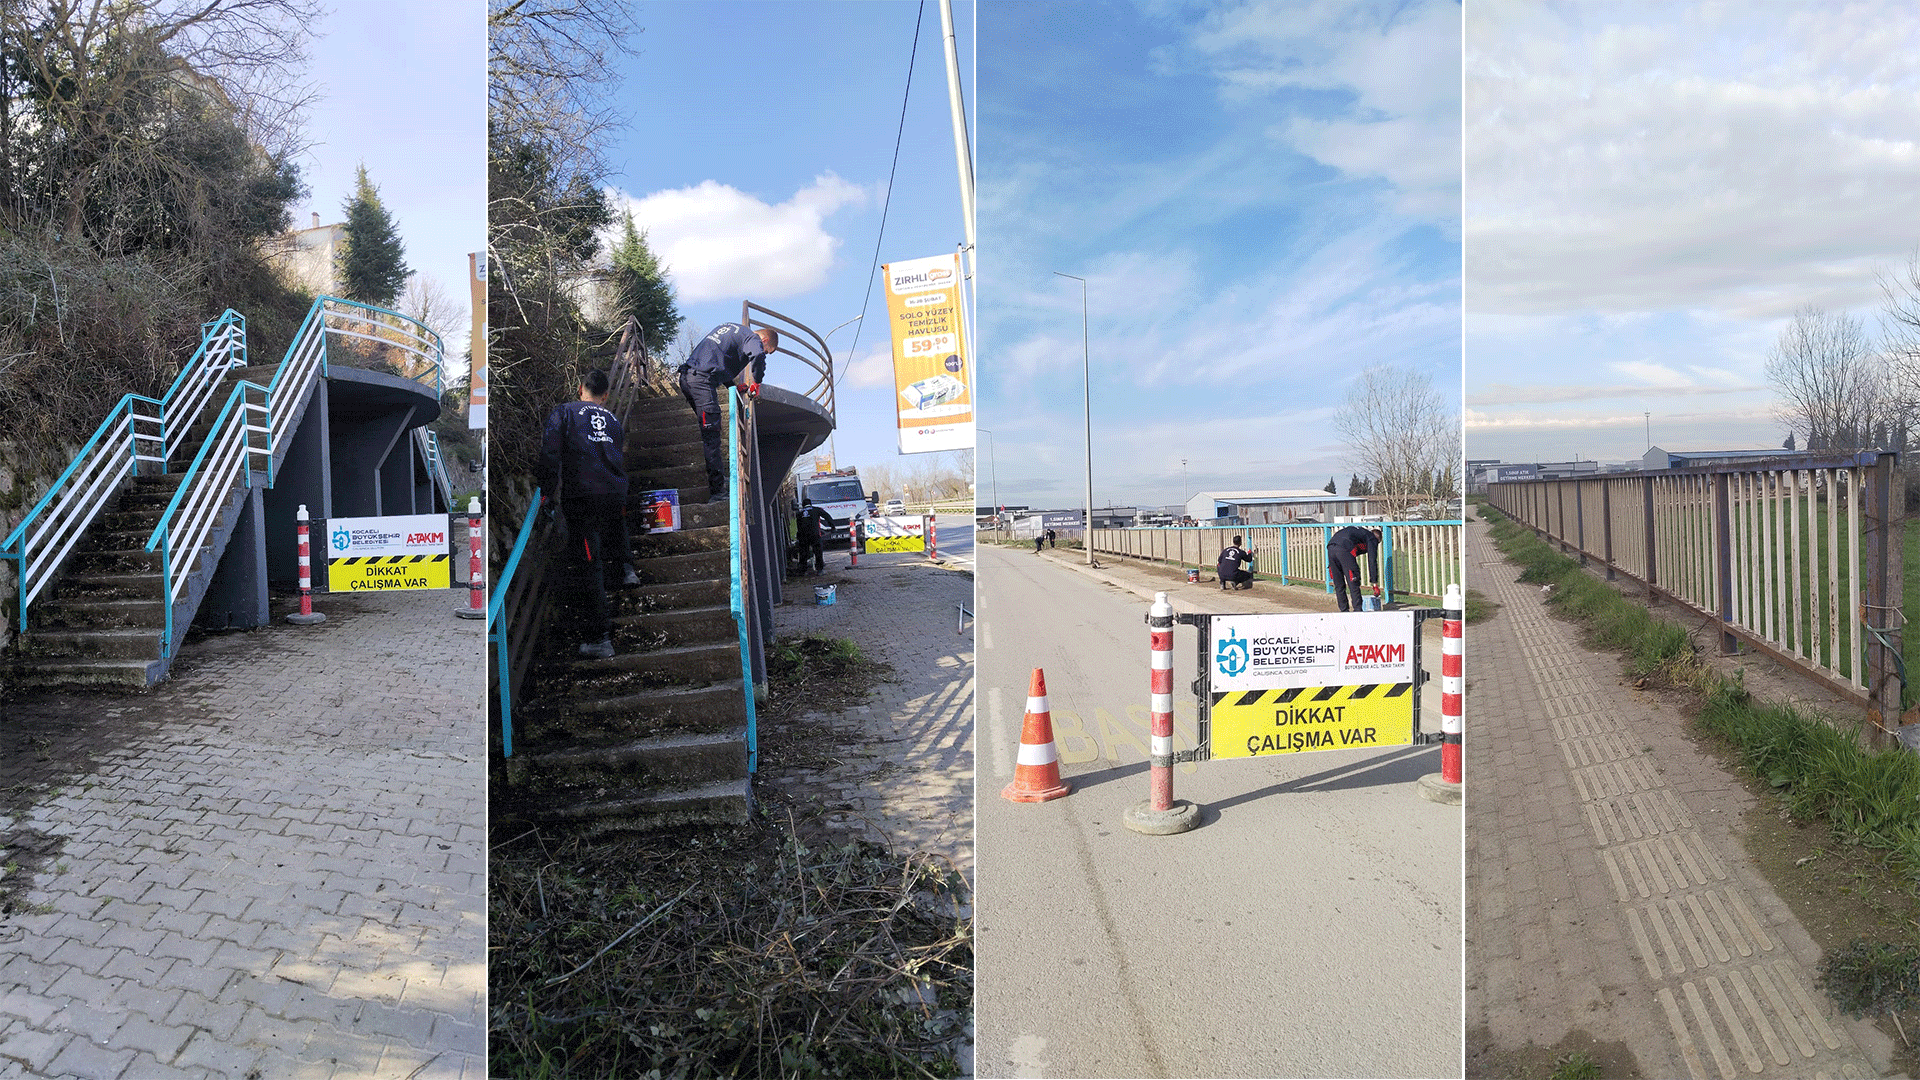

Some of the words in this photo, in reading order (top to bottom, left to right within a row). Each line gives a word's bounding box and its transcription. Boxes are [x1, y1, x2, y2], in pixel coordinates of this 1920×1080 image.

[894, 273, 927, 286] ZIRHLI
[900, 311, 923, 320] SOLO
[925, 307, 954, 317] YÜZEY
[908, 317, 947, 327] TEMİZLİK
[908, 325, 949, 336] HAVLUSU
[366, 565, 408, 576] DİKKAT
[350, 579, 402, 591] ÇALIŞMA
[404, 578, 428, 587] VAR
[1345, 644, 1405, 664] A-TAKIMI
[1275, 705, 1346, 727] DİKKAT
[1247, 730, 1335, 756] ÇALIŞMA
[1339, 727, 1377, 745] VAR
